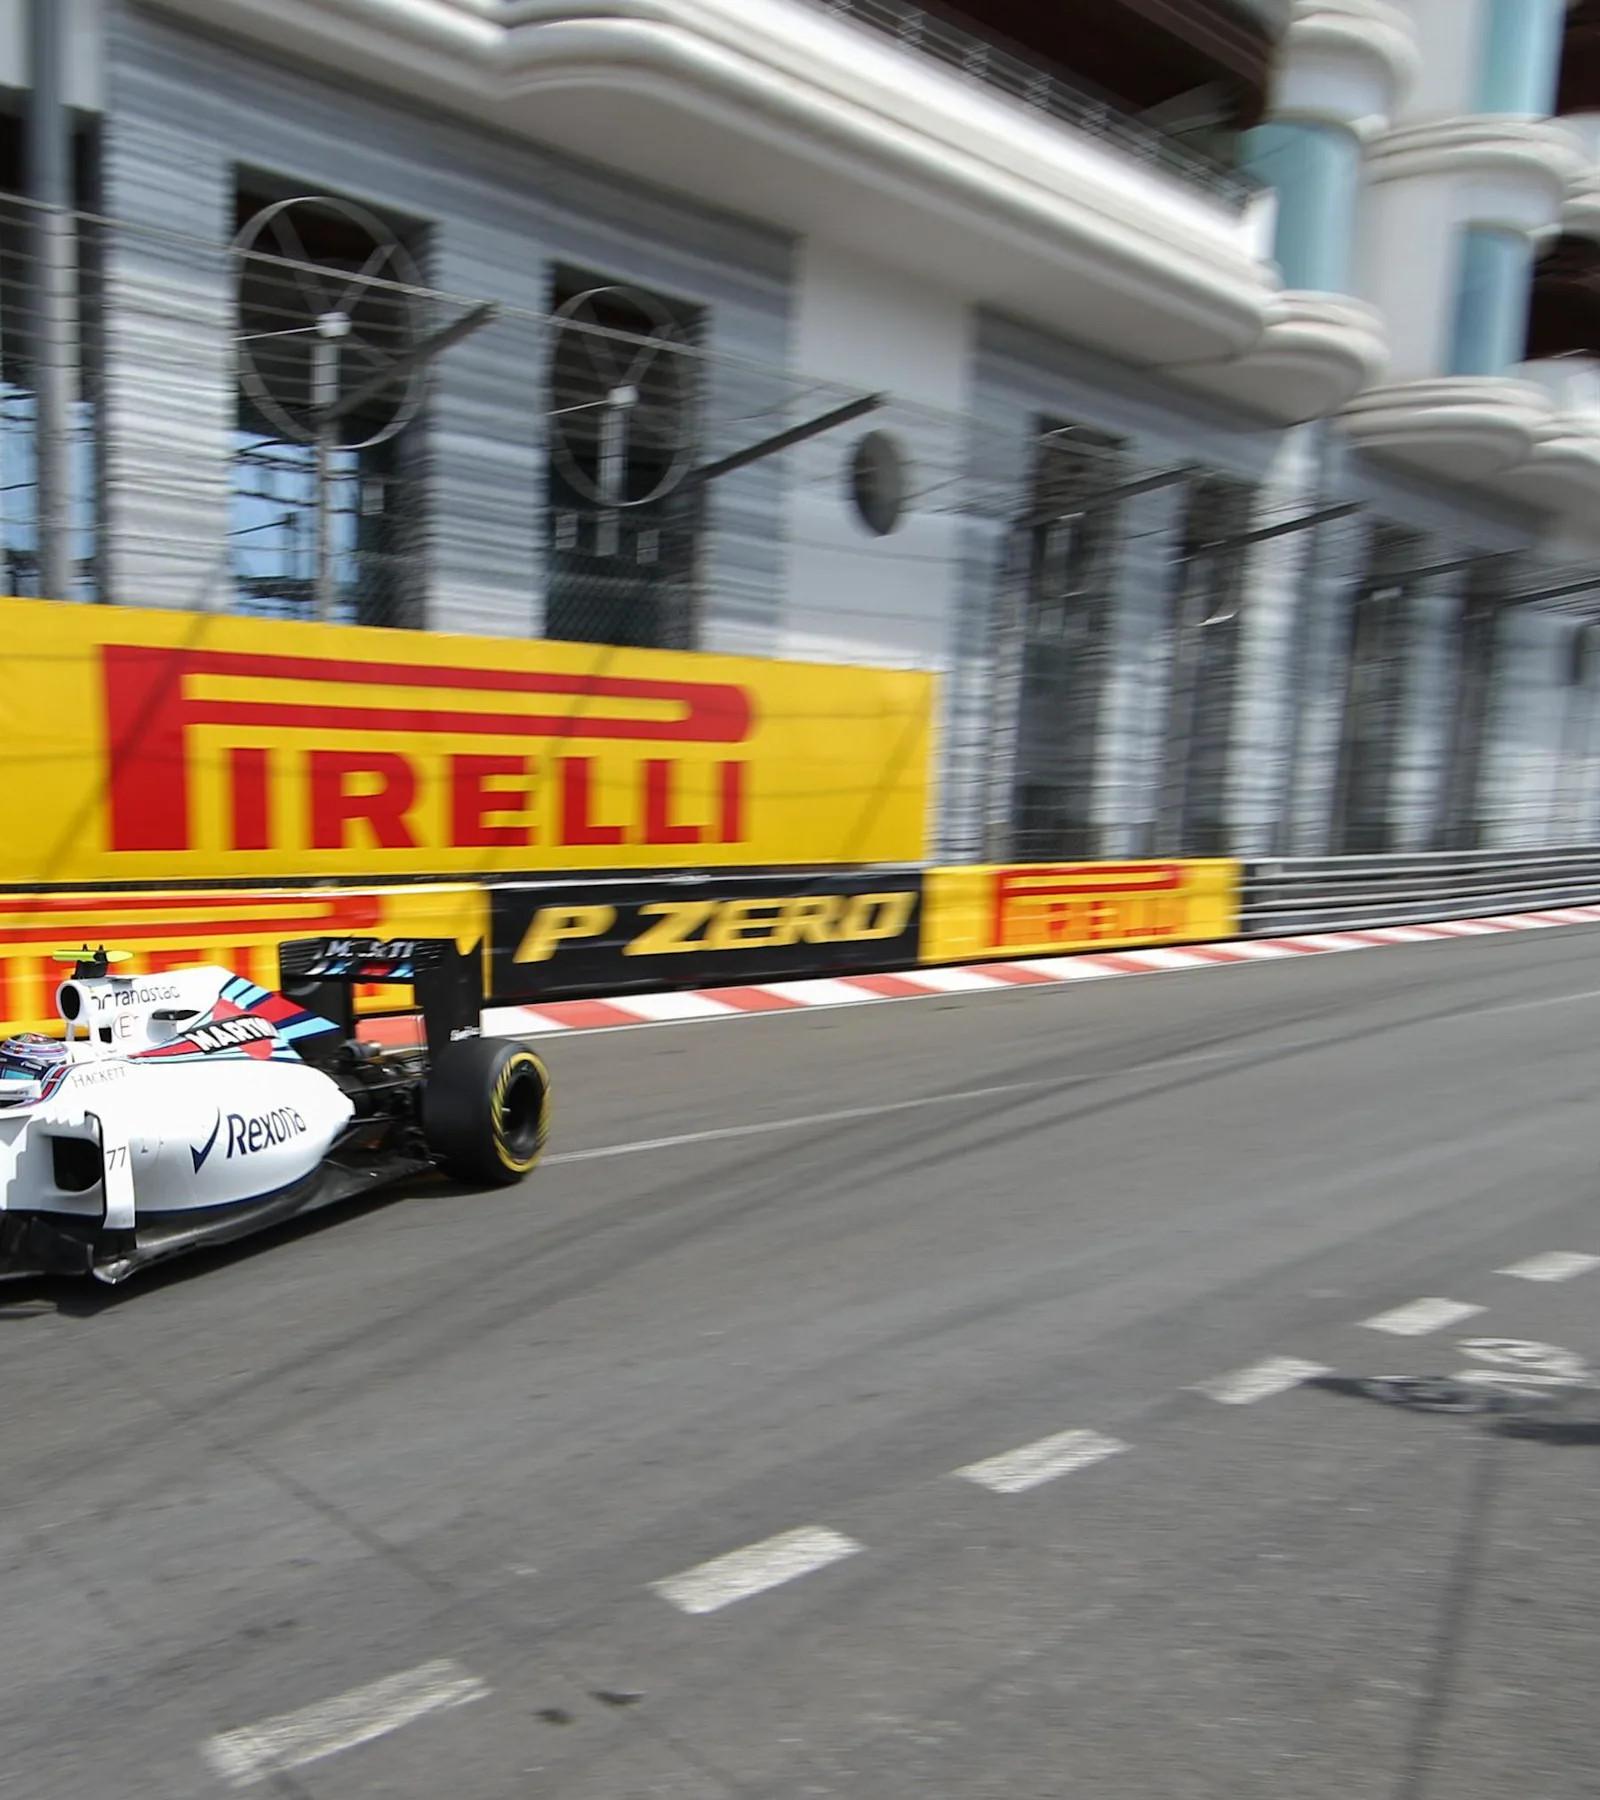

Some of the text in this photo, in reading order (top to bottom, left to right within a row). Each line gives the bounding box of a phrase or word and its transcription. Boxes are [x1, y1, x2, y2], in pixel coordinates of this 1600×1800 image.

[102, 644, 758, 852] PIRELLI
[513, 890, 918, 963] P ZERO
[106, 1146, 126, 1170] 77
[226, 1106, 307, 1159] Rexona
